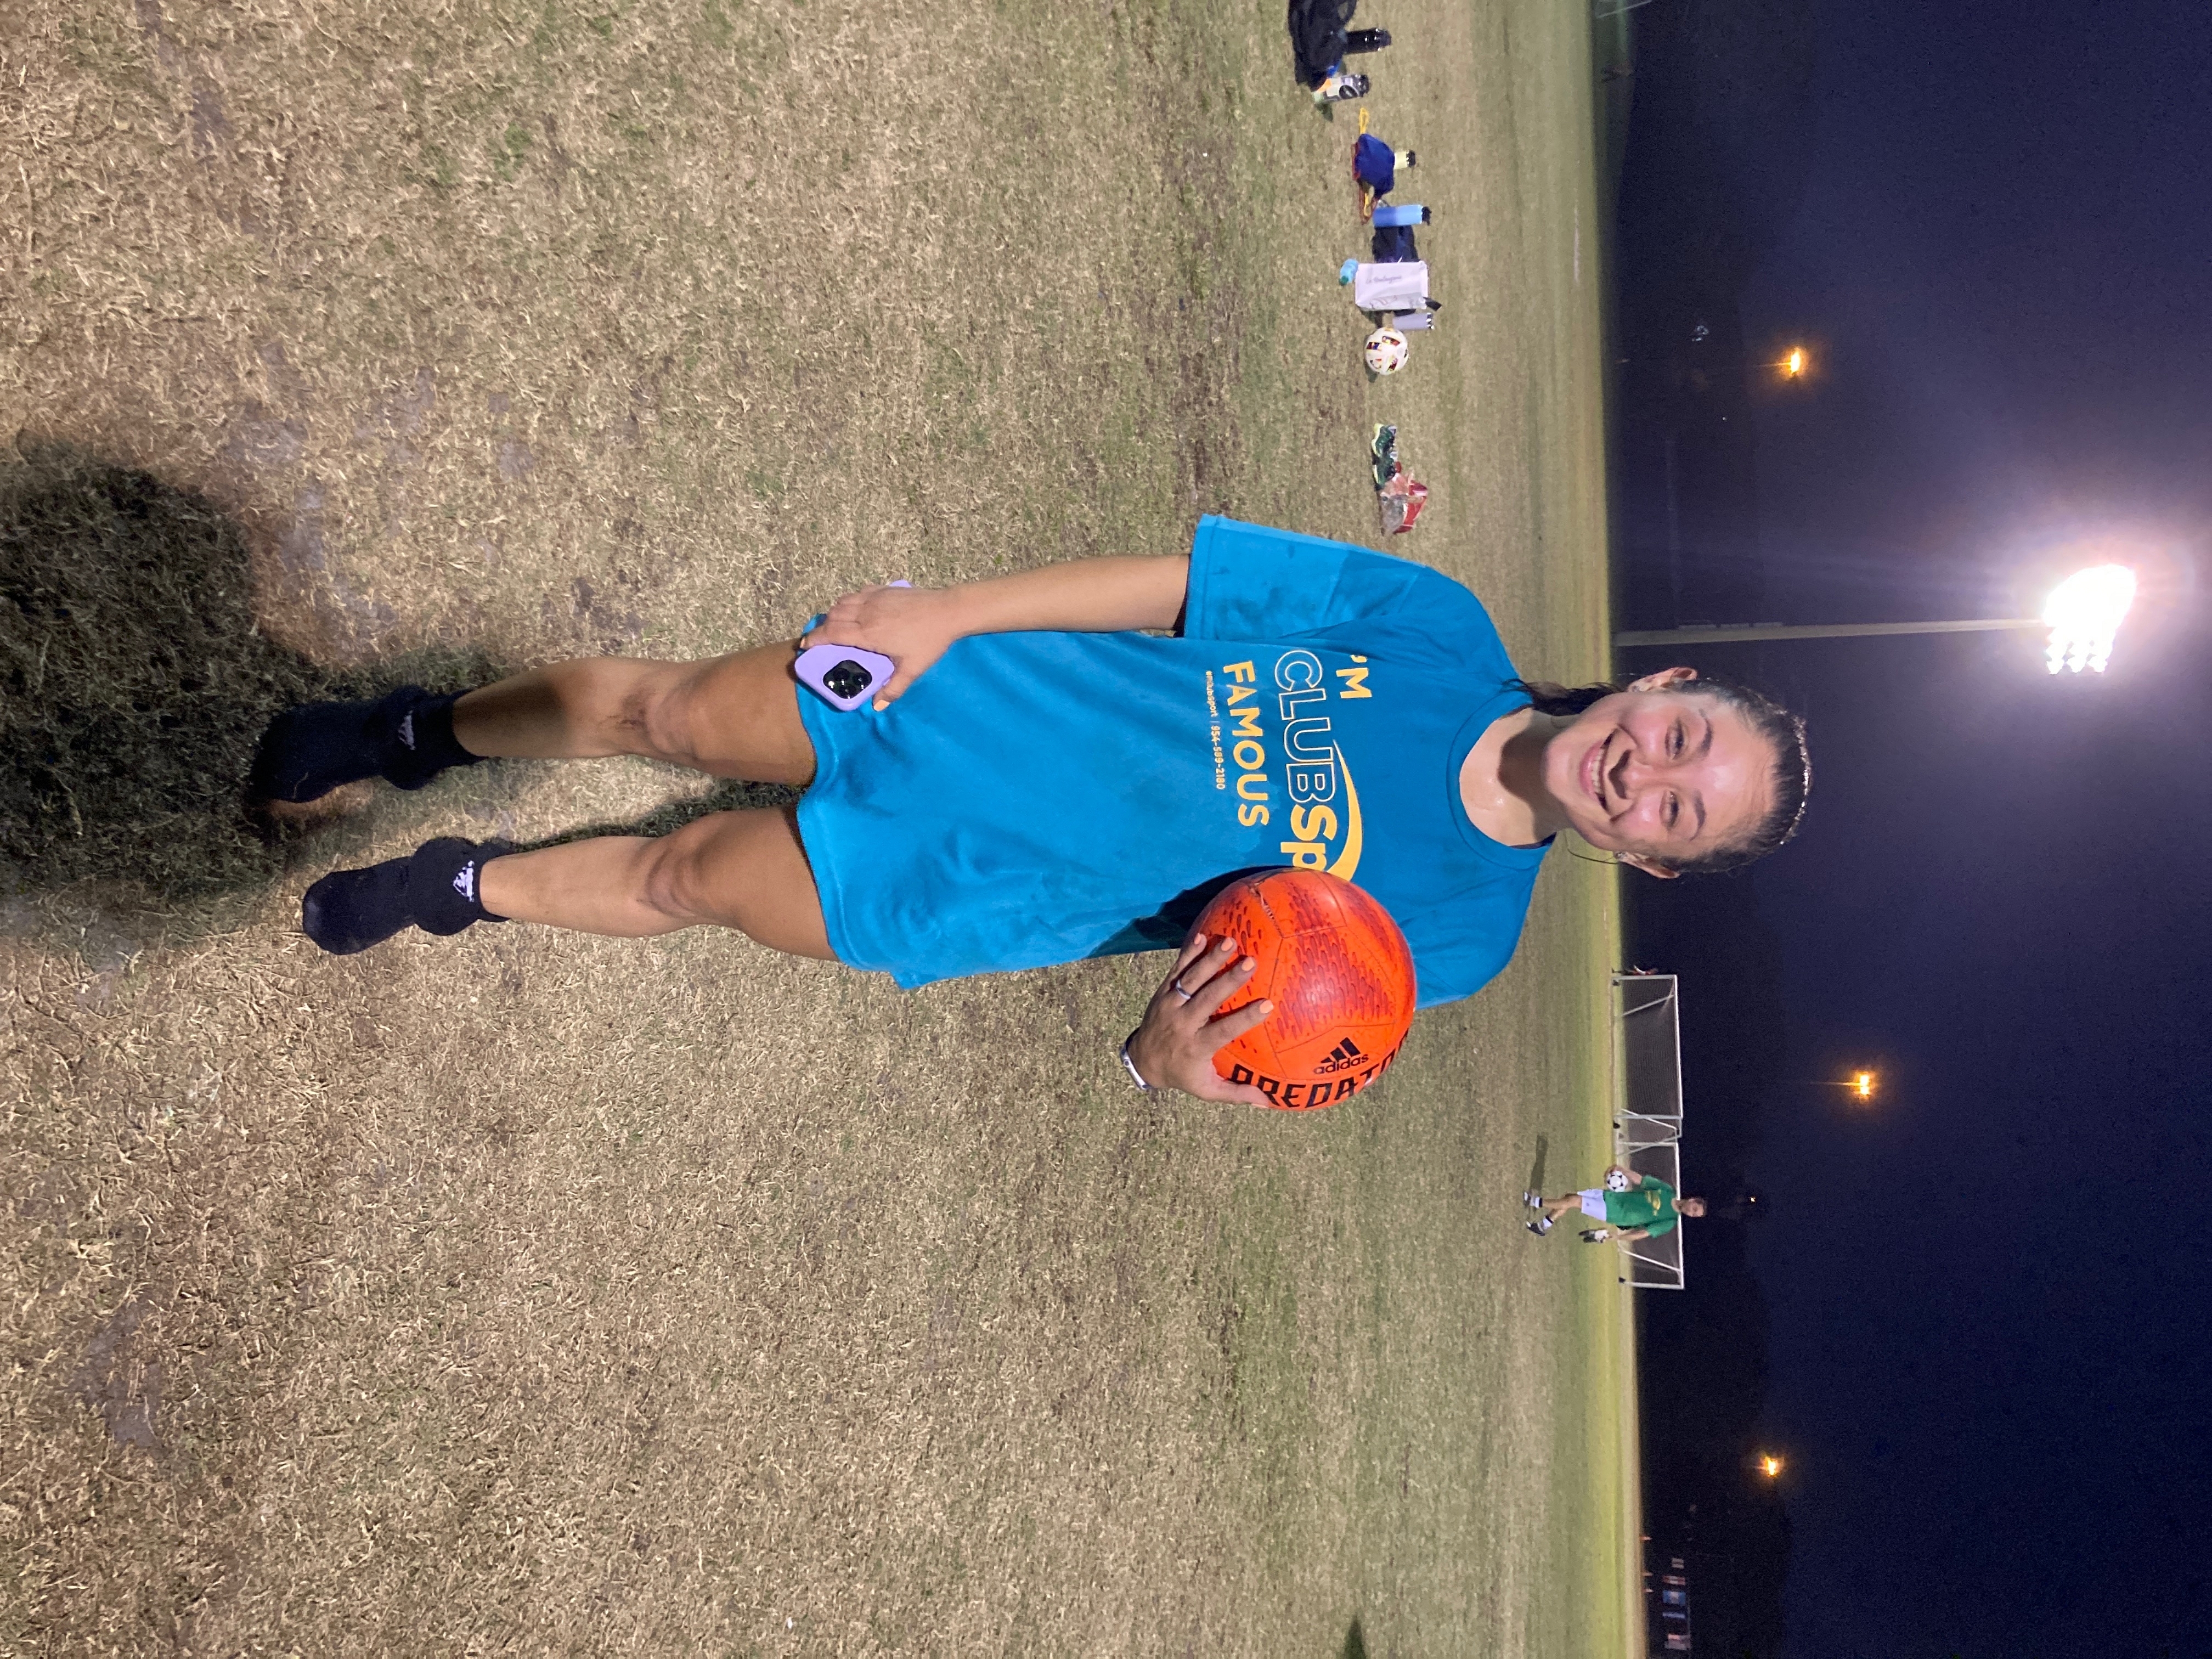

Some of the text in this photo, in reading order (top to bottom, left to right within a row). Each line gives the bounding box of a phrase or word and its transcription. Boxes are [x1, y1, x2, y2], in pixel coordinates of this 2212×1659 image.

[1223, 661, 1269, 827] FAMOUS
[1228, 1028, 1409, 1108] PREDATO
[1313, 1053, 1369, 1075] adidas
